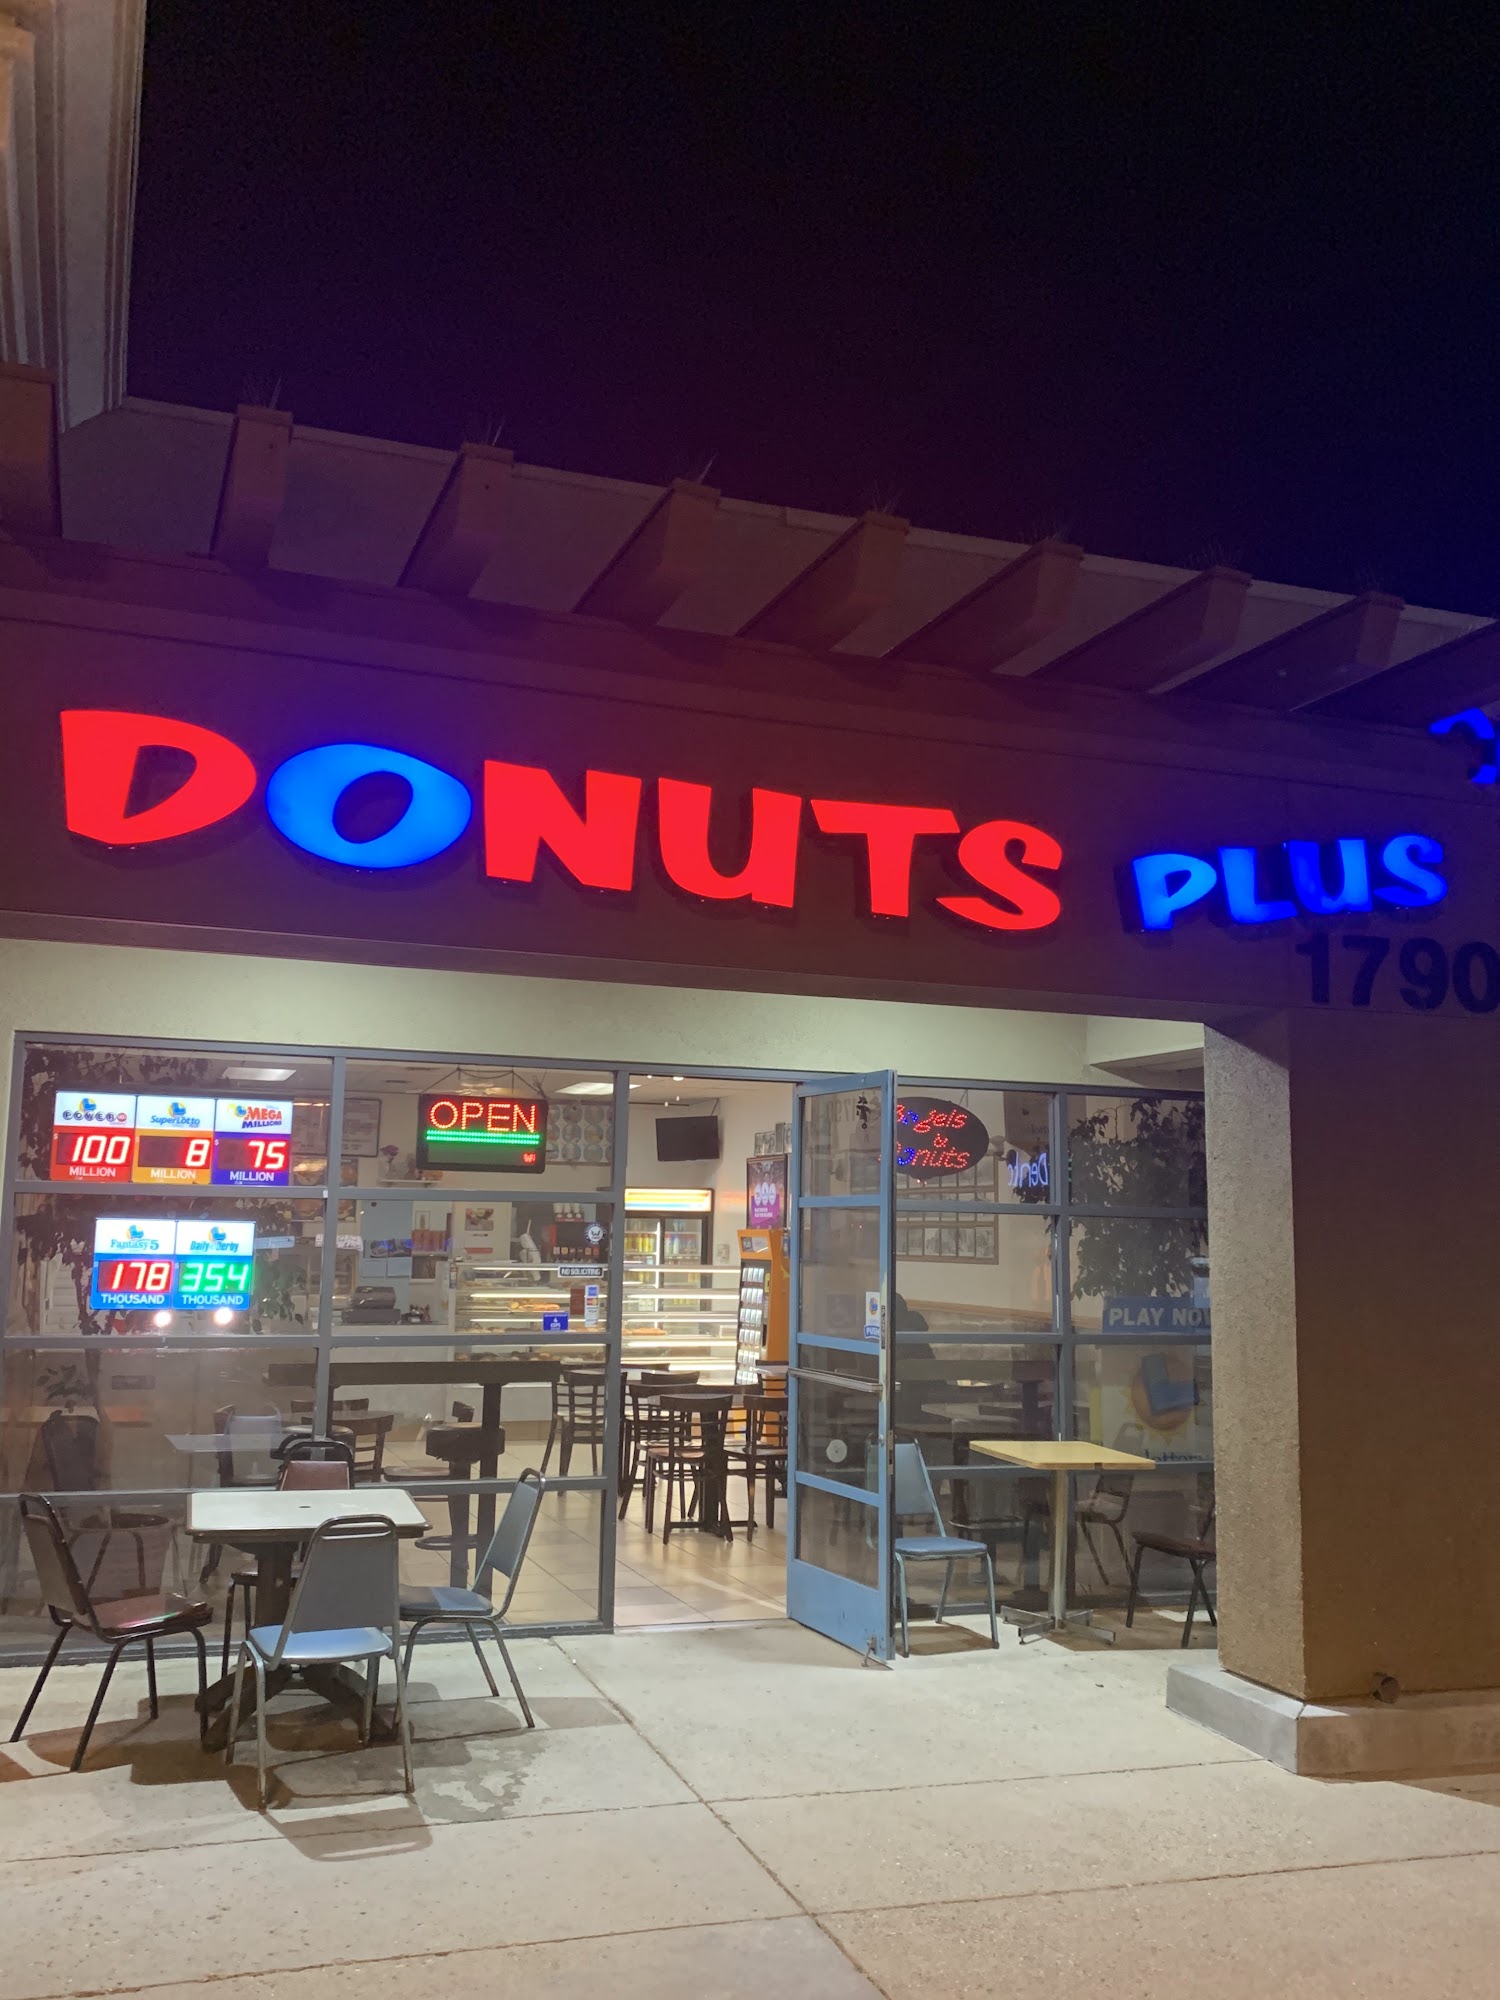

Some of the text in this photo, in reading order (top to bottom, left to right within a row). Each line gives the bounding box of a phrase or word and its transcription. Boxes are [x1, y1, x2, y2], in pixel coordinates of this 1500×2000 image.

[61, 710, 1449, 931] DONUTS PLUS
[1296, 932, 1500, 1014] 1790
[245, 1106, 283, 1120] MEGA
[430, 1101, 536, 1133] OPEN
[242, 1120, 283, 1129] MILLIONS
[72, 1135, 131, 1164] 100
[185, 1139, 211, 1167] 8
[248, 1141, 287, 1169] 75
[897, 1142, 971, 1168] onuts
[69, 1166, 117, 1178] MILLION
[150, 1168, 197, 1179] MILLION
[229, 1171, 275, 1182] MILLION
[110, 1239, 160, 1251] Fantasy 5
[190, 1240, 239, 1253] Daily Derby
[111, 1262, 170, 1291] 178
[180, 1263, 249, 1292] 354
[101, 1293, 165, 1305] THOUSAND
[181, 1294, 244, 1306] THOUSAND
[1109, 1307, 1165, 1326] PLAY
